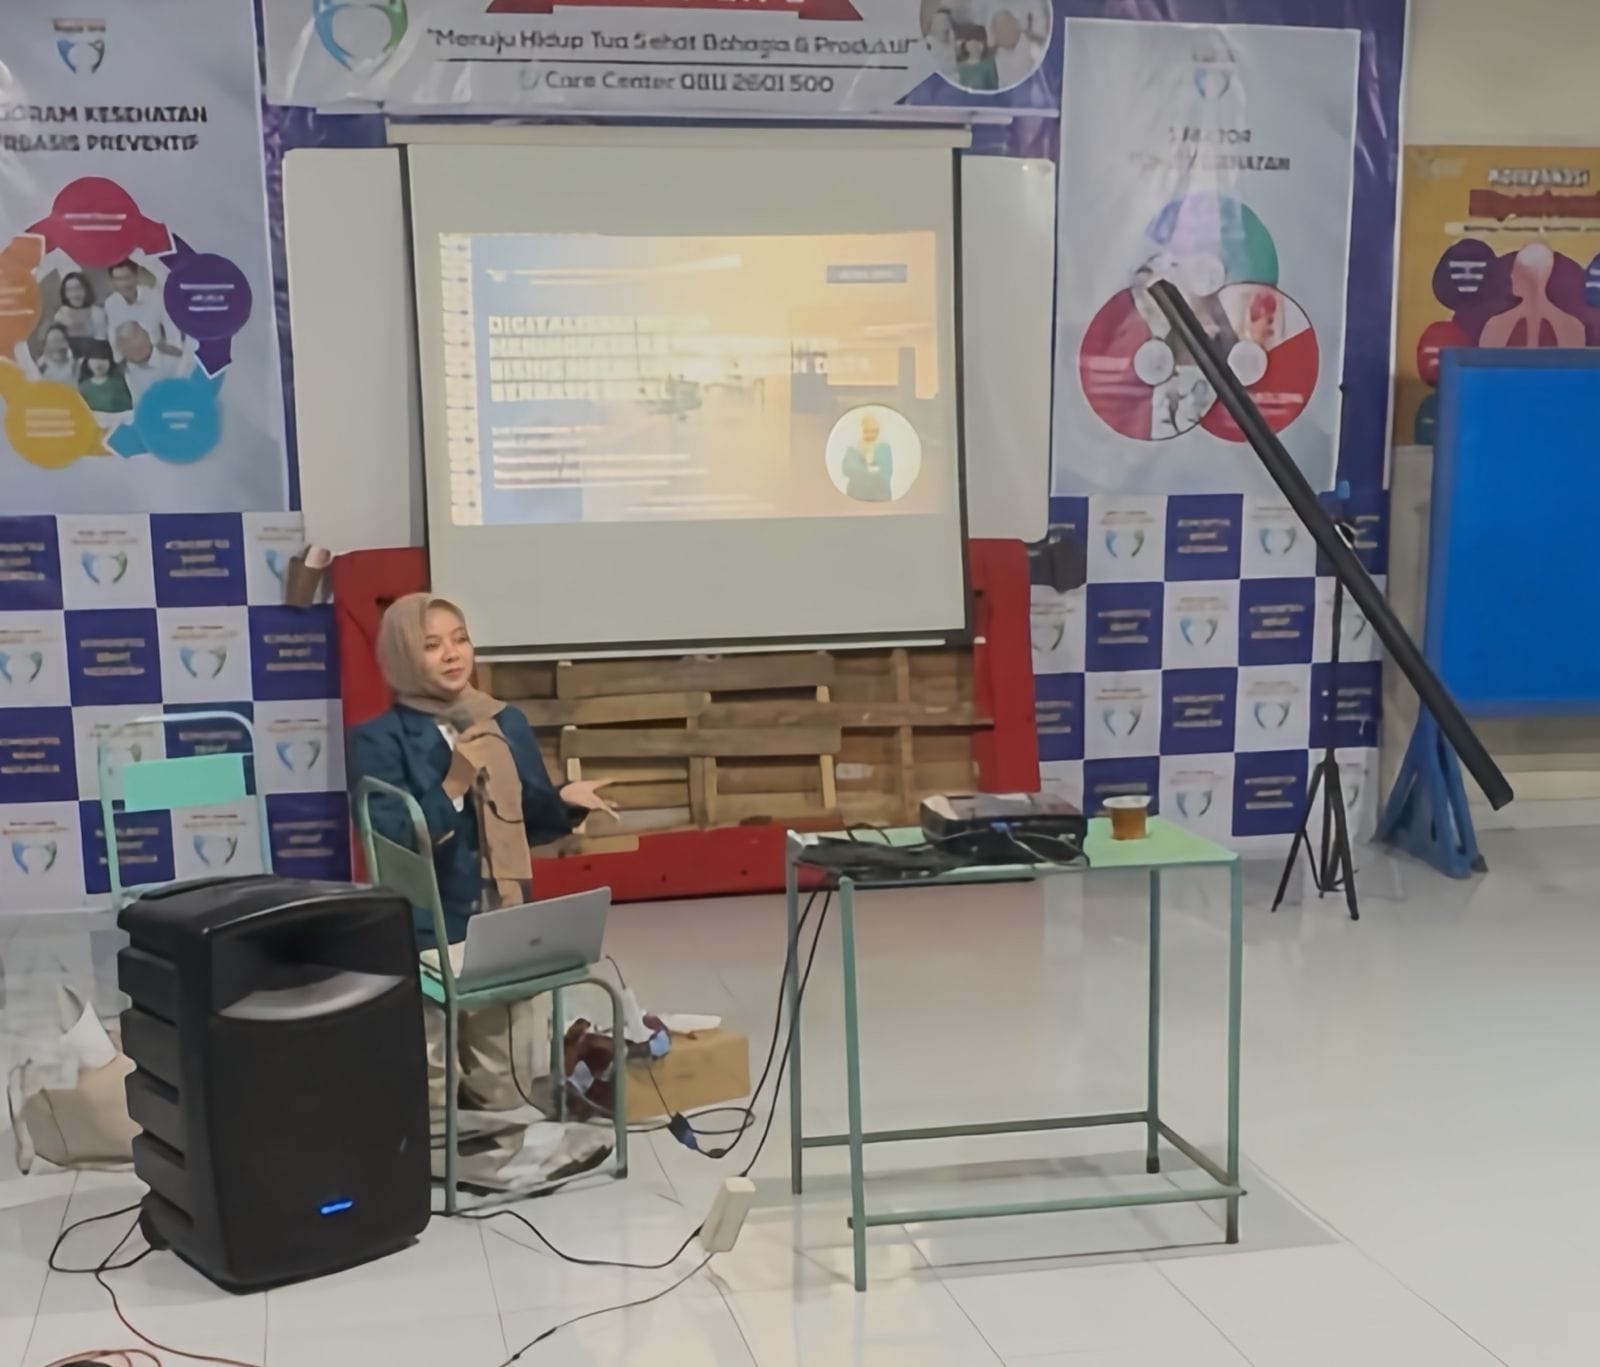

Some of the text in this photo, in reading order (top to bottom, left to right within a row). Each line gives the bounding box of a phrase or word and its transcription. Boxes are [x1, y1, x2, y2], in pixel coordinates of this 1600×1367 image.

[591, 31, 629, 49] Tua
[545, 71, 596, 89] Care
[602, 72, 675, 90] Center
[789, 75, 834, 92] 500
